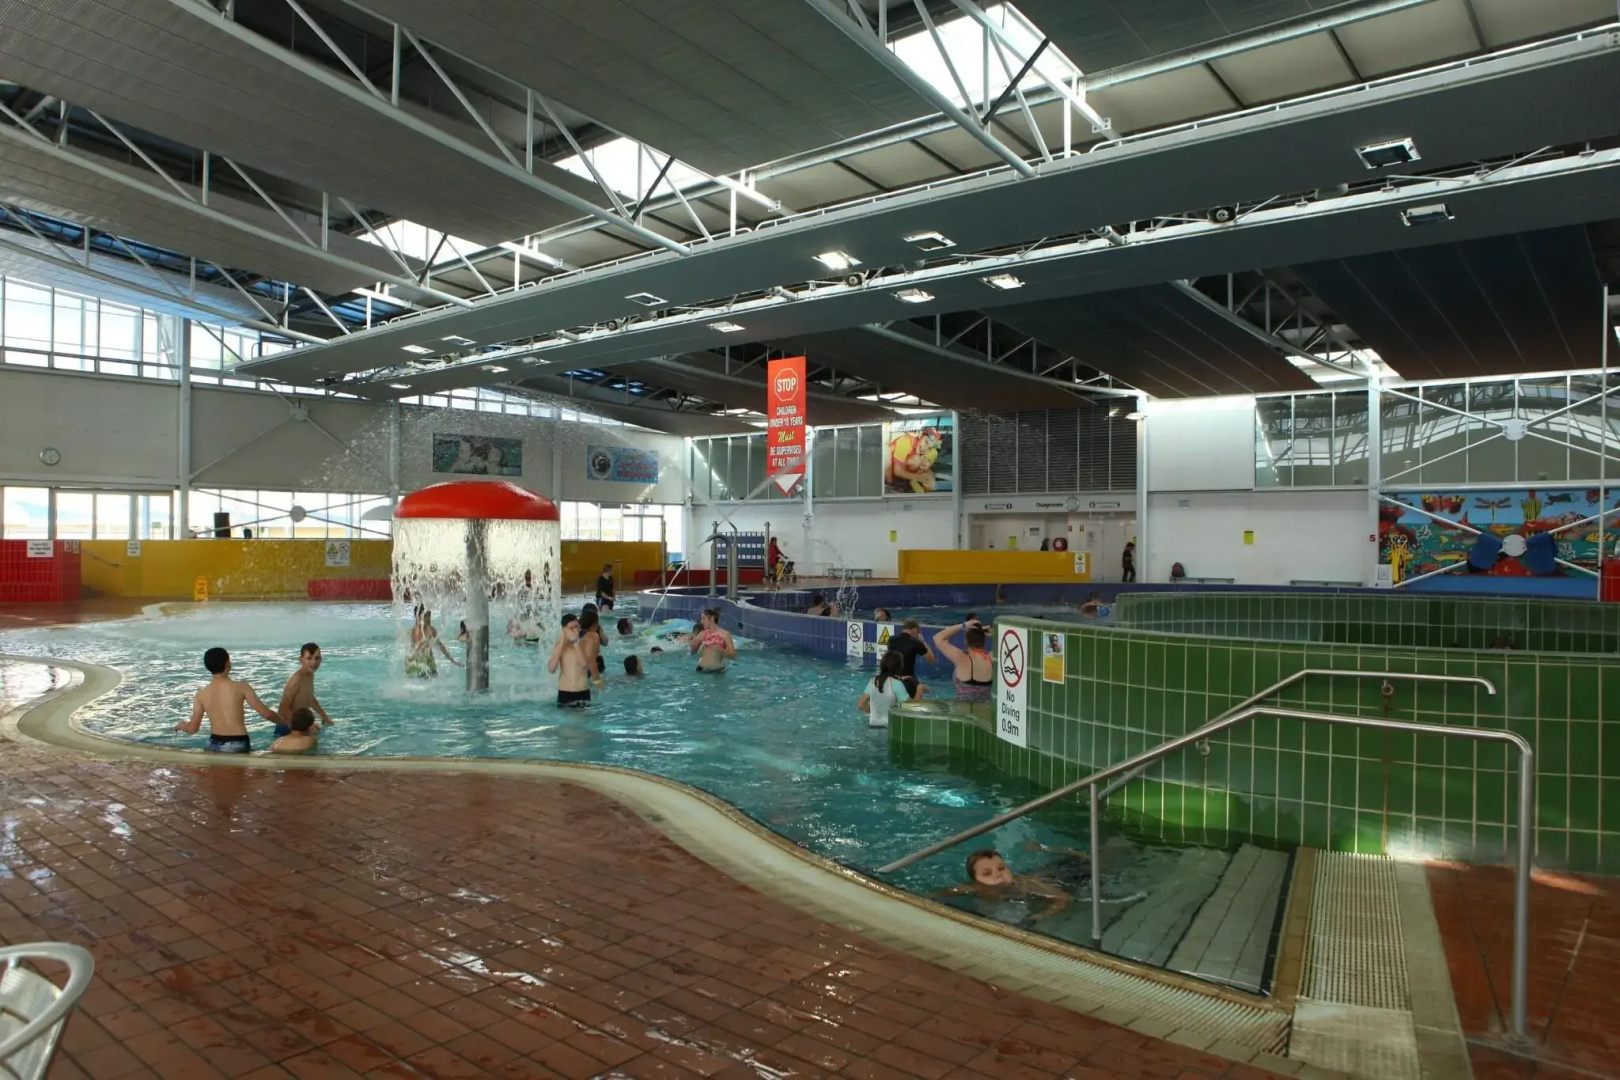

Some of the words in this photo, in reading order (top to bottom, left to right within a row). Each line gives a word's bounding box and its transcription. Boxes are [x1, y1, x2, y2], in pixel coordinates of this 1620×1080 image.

[777, 378, 796, 392] STOP
[777, 405, 797, 416] CHILDREN
[769, 418, 783, 428] UNDER
[783, 417, 789, 426] 10
[791, 416, 803, 426] YEARS
[777, 430, 795, 443] Must
[770, 446, 776, 456] BE
[776, 445, 801, 455] SUPERVISED
[772, 457, 777, 467] AT
[777, 457, 786, 467] ALL
[1370, 534, 1376, 542] 5
[1006, 690, 1015, 702] No
[1001, 702, 1020, 722] Diving
[1001, 718, 1019, 737] 0.9m
